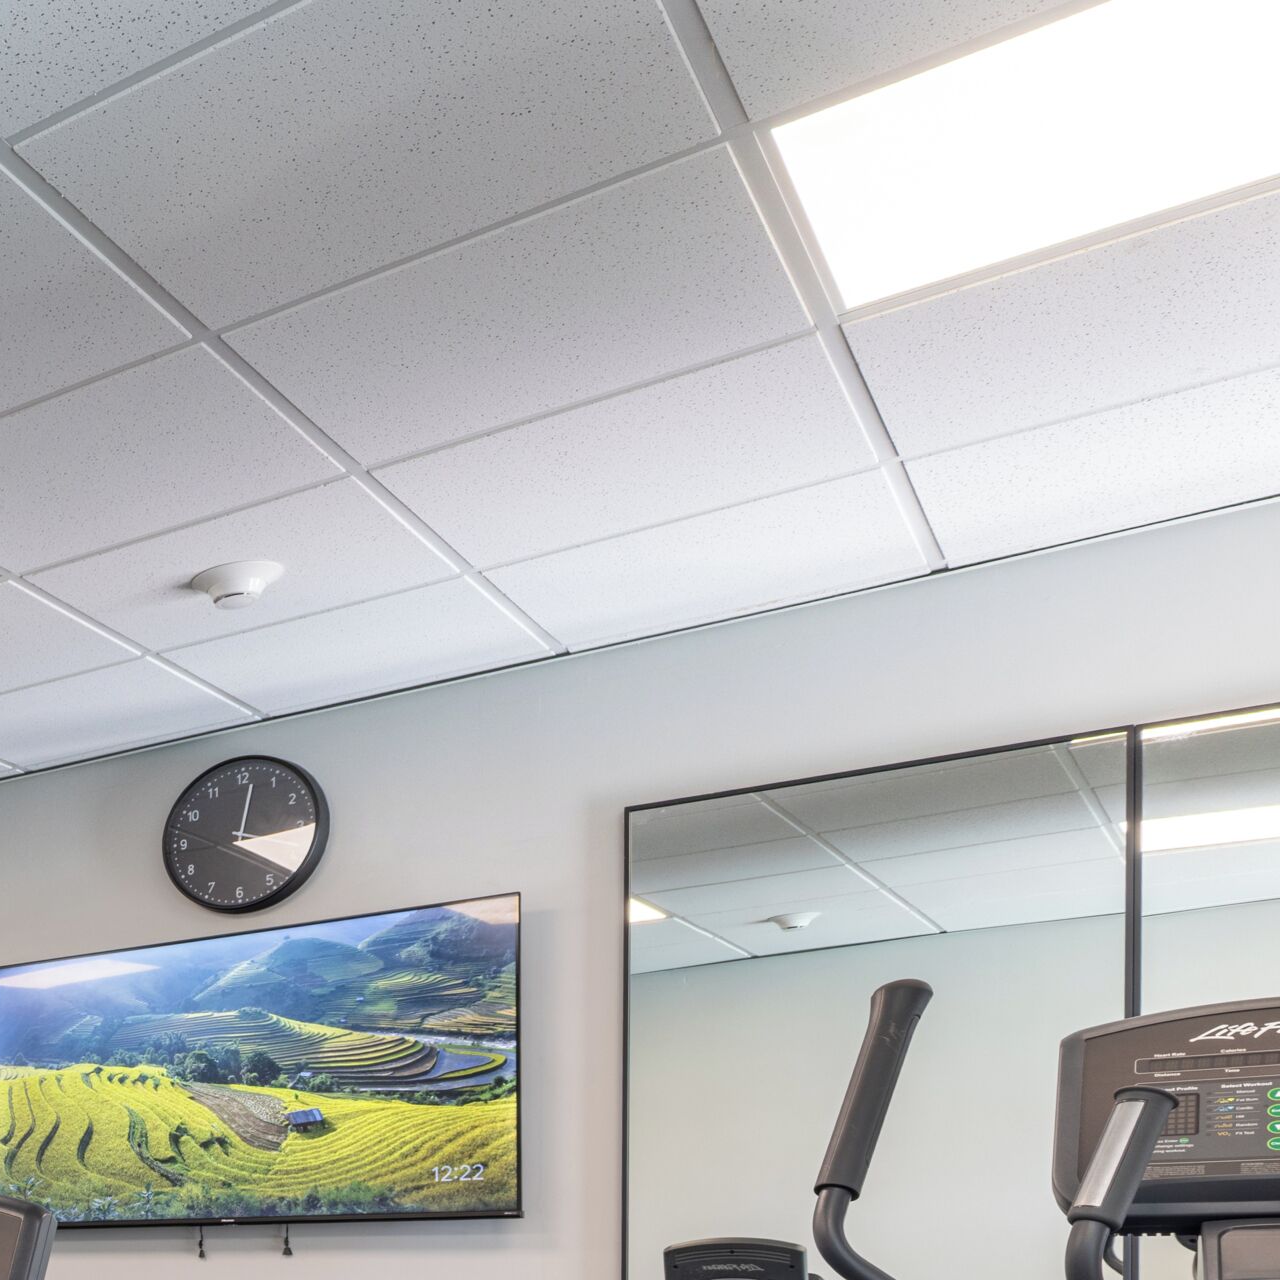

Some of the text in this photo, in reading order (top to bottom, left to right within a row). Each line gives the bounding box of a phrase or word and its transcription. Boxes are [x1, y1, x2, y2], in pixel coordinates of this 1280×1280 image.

[236, 772, 249, 785] 12
[271, 777, 276, 788] 1
[208, 787, 219, 799] 11
[289, 793, 297, 805] 2
[187, 810, 199, 822] 10
[180, 839, 187, 850] 9
[187, 864, 195, 875] 8
[266, 874, 274, 886] 5
[208, 881, 216, 893] 7
[236, 887, 244, 898] 6
[431, 1163, 485, 1182] 12:22
